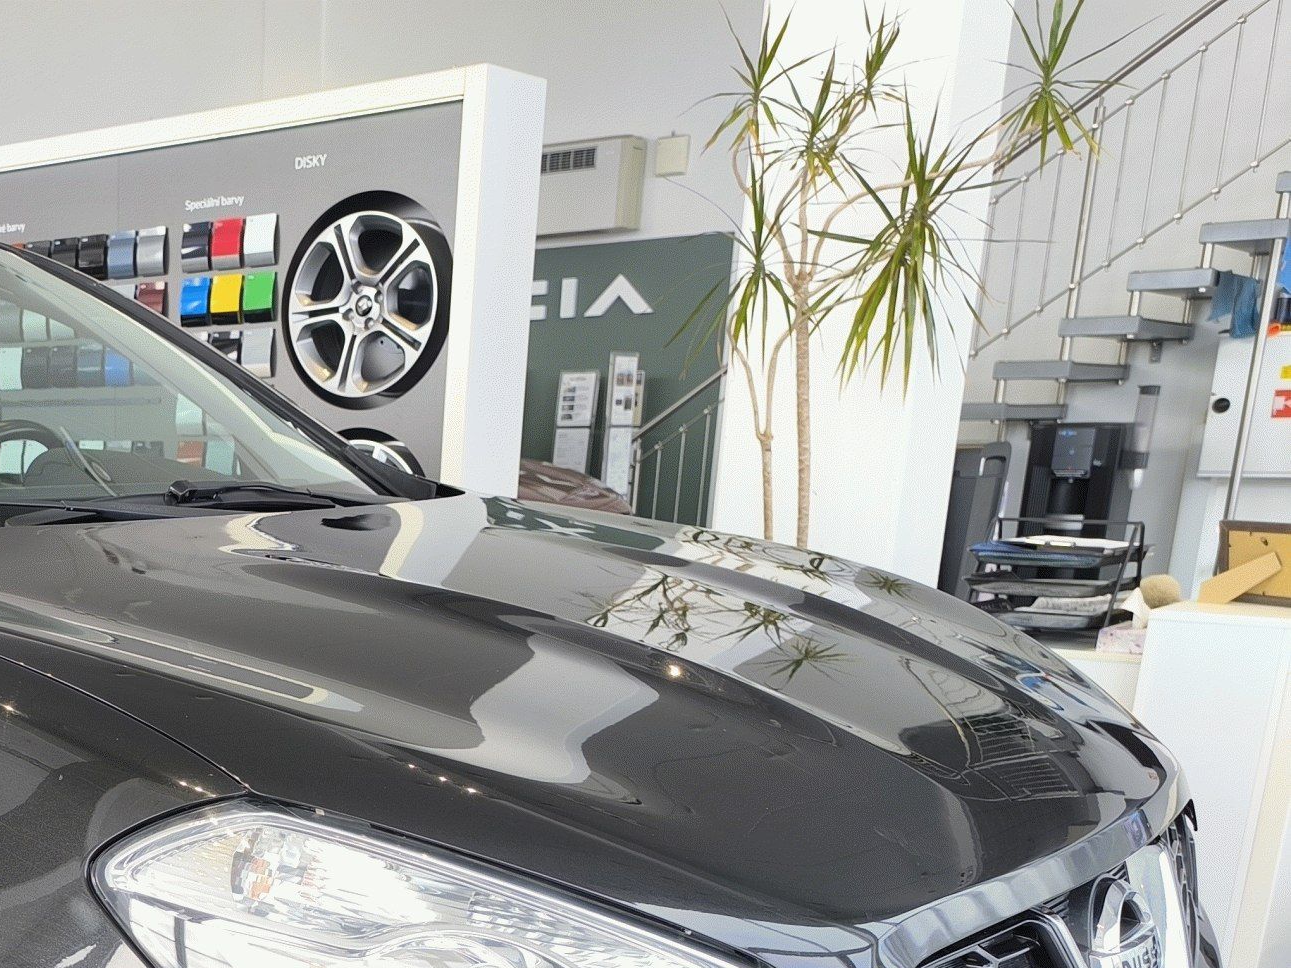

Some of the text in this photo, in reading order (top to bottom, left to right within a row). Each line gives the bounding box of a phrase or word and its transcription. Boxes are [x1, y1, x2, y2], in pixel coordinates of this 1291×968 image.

[294, 153, 328, 170] DISKY
[220, 195, 245, 207] barvy
[6, 223, 26, 233] barvy
